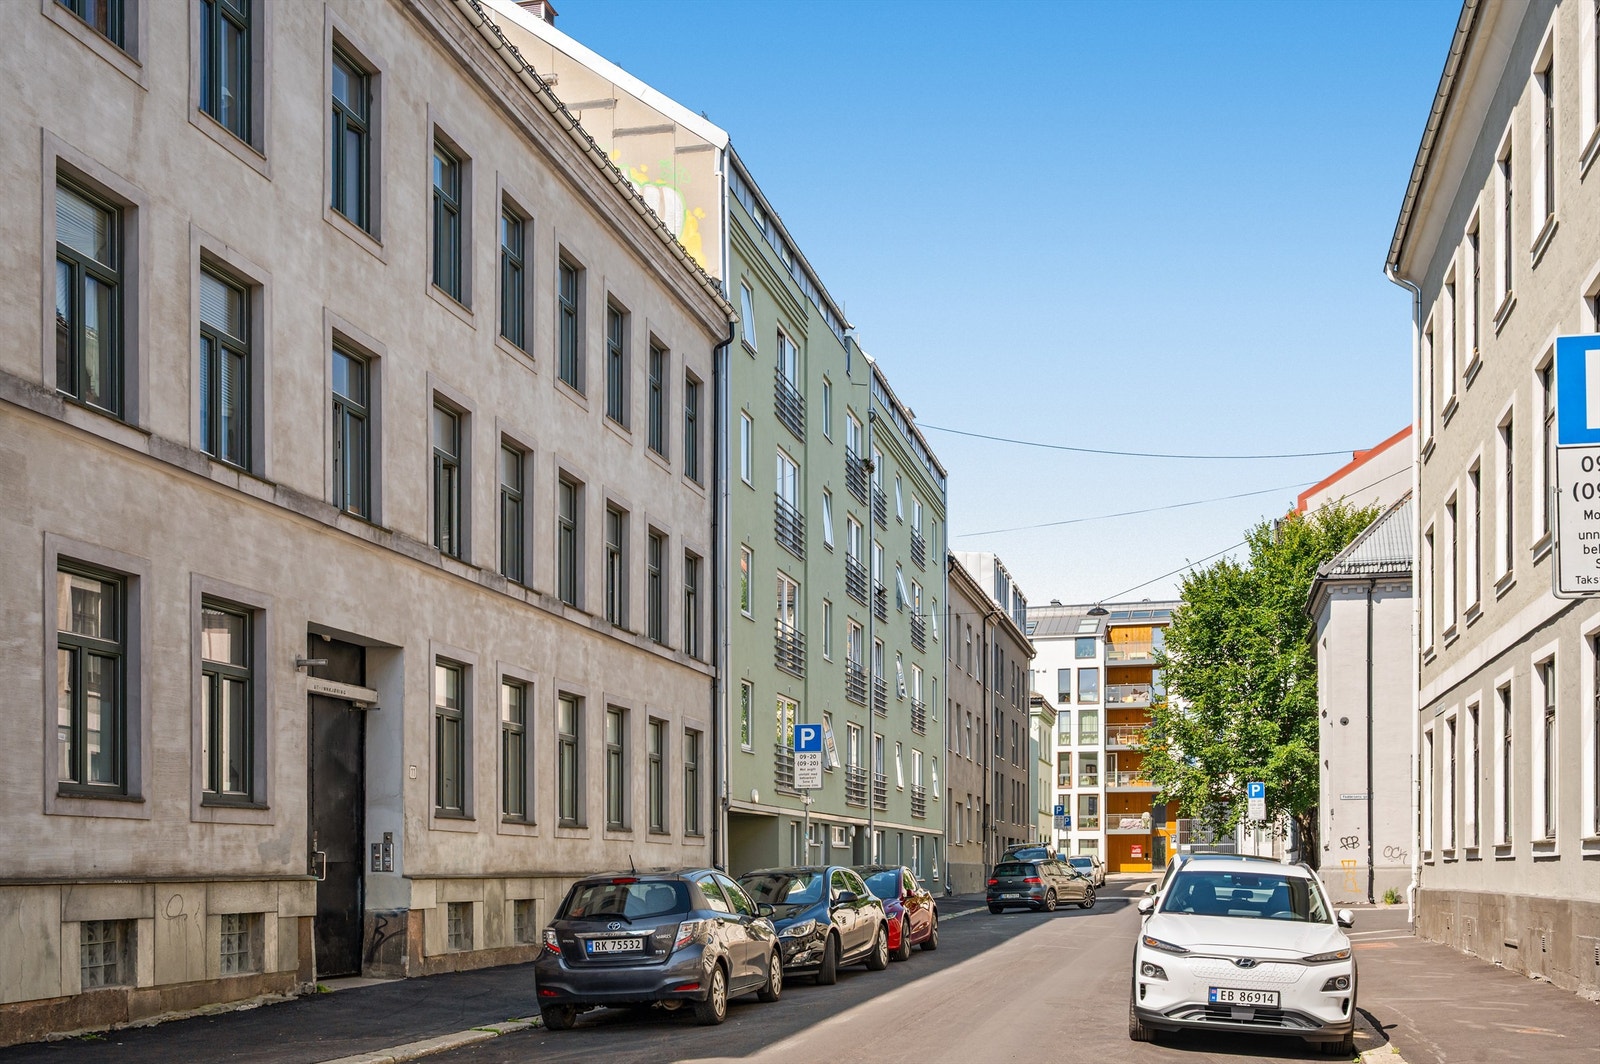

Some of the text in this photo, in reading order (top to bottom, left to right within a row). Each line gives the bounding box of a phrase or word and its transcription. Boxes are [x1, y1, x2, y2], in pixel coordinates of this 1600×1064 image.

[1583, 544, 1600, 555] be
[800, 727, 816, 749] P
[1251, 784, 1261, 797] P
[1056, 806, 1063, 815] P
[1064, 817, 1070, 825] P
[595, 940, 641, 951] RK 75532
[1221, 990, 1274, 1004] EB 86914
